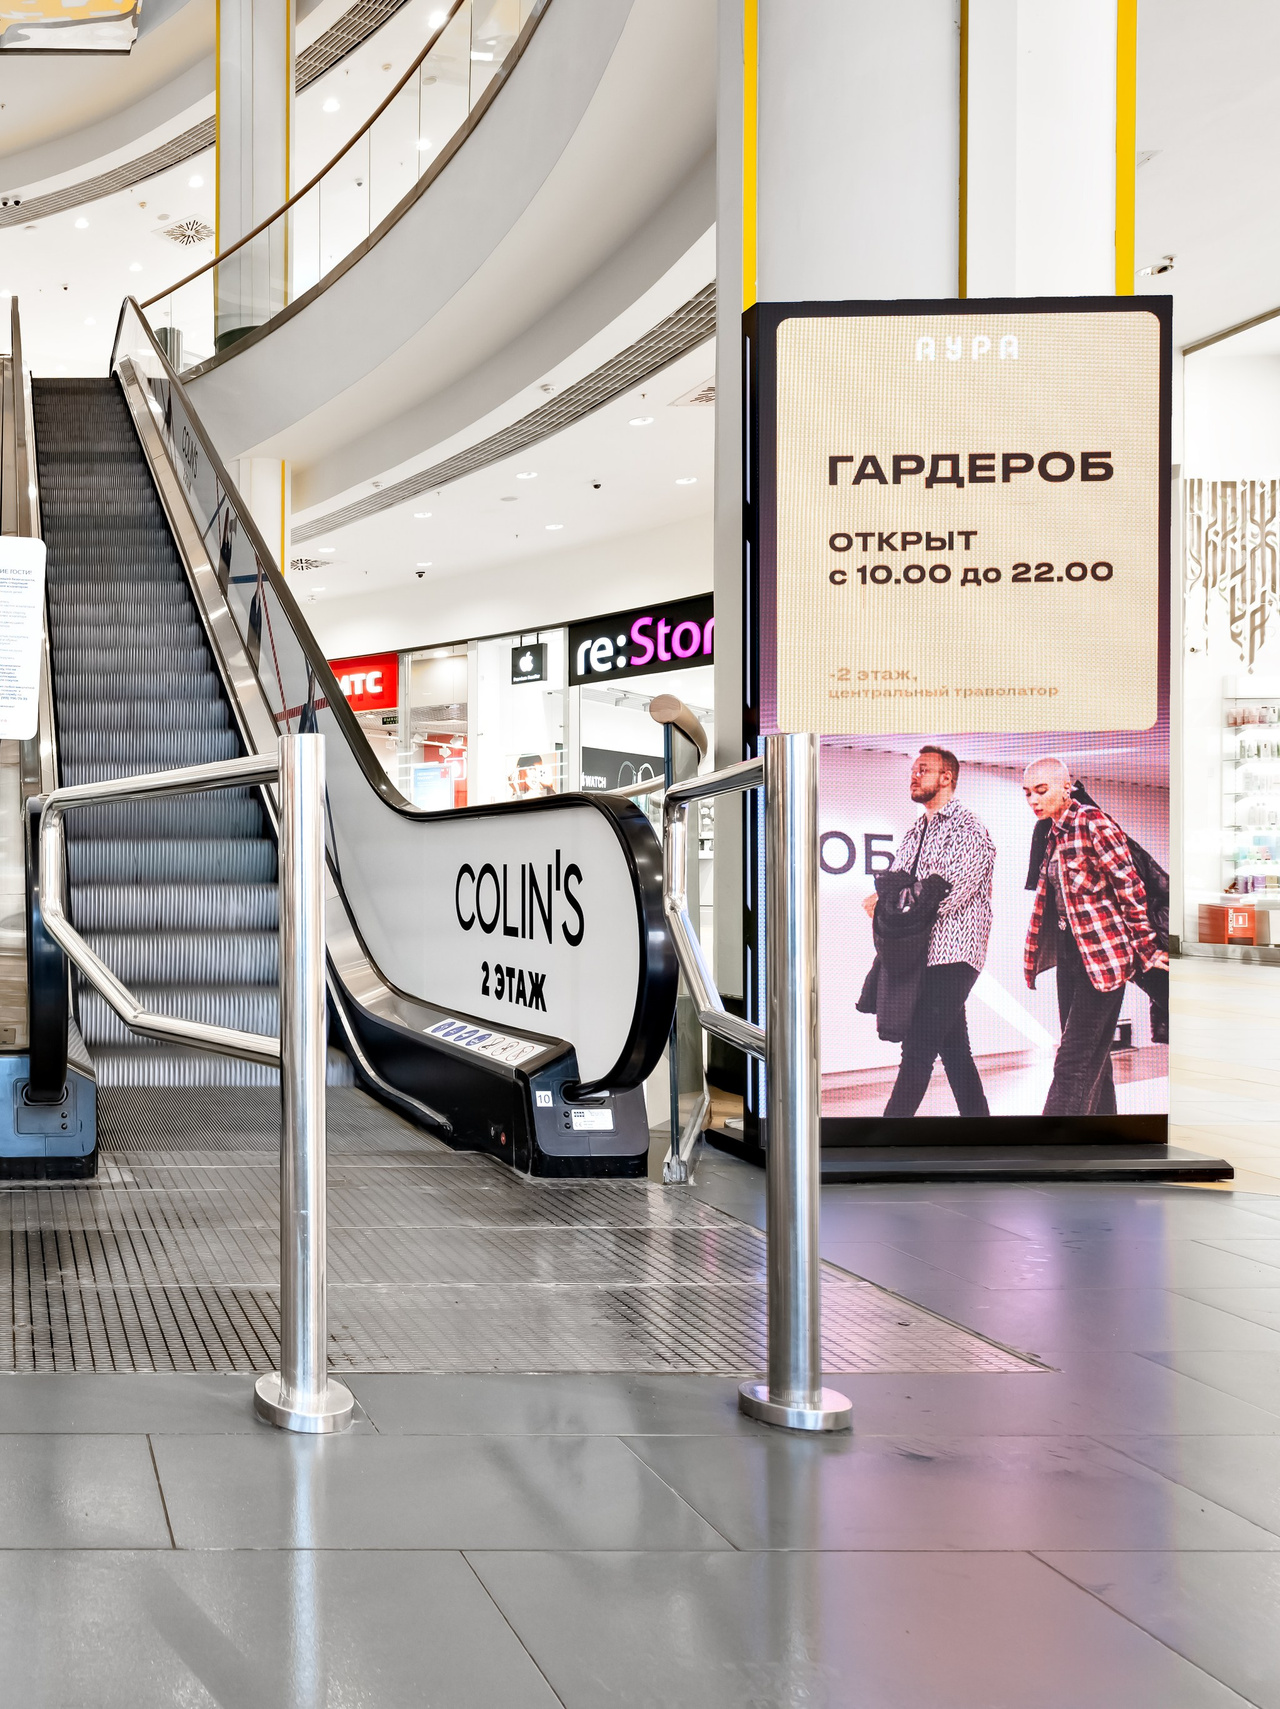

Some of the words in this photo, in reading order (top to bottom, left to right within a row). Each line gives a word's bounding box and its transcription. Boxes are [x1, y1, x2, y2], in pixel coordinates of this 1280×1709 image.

[916, 335, 1019, 361] АУРА
[828, 451, 1115, 489] ГАРДЕРОБ
[828, 530, 979, 553] ОТКРЫТ
[828, 567, 848, 586] с
[856, 563, 952, 586] 10.00
[961, 566, 1002, 587] до
[1011, 560, 1115, 583] 22.00
[828, 685, 950, 700] центральный
[955, 686, 1059, 700] траволатор
[455, 849, 585, 947] COLIN'S
[481, 961, 490, 997] 2
[494, 963, 548, 1013] ЭТАЖ
[537, 1094, 551, 1104] 10
